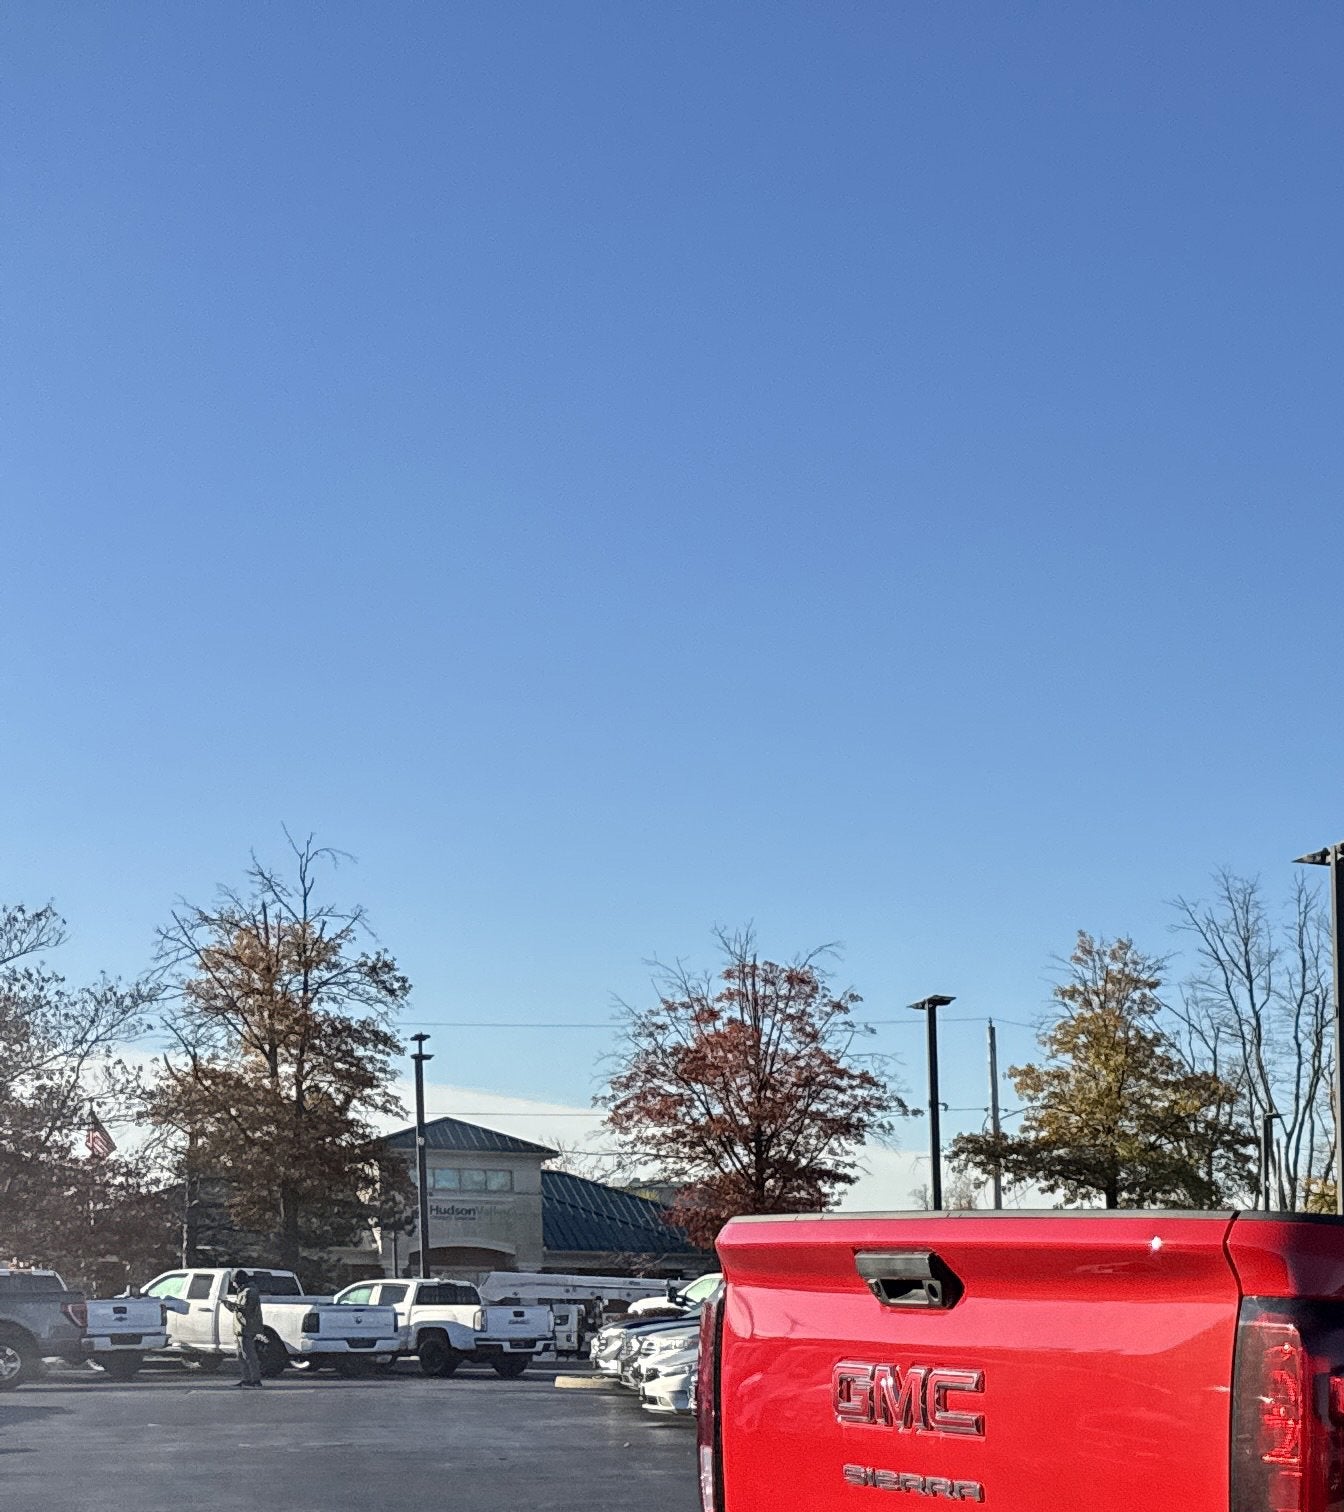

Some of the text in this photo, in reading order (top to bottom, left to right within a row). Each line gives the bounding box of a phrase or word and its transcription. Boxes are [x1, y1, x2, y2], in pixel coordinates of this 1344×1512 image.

[429, 1205, 476, 1216] Hudson
[832, 1358, 985, 1437] GMC
[843, 1463, 985, 1503] SIERRA
